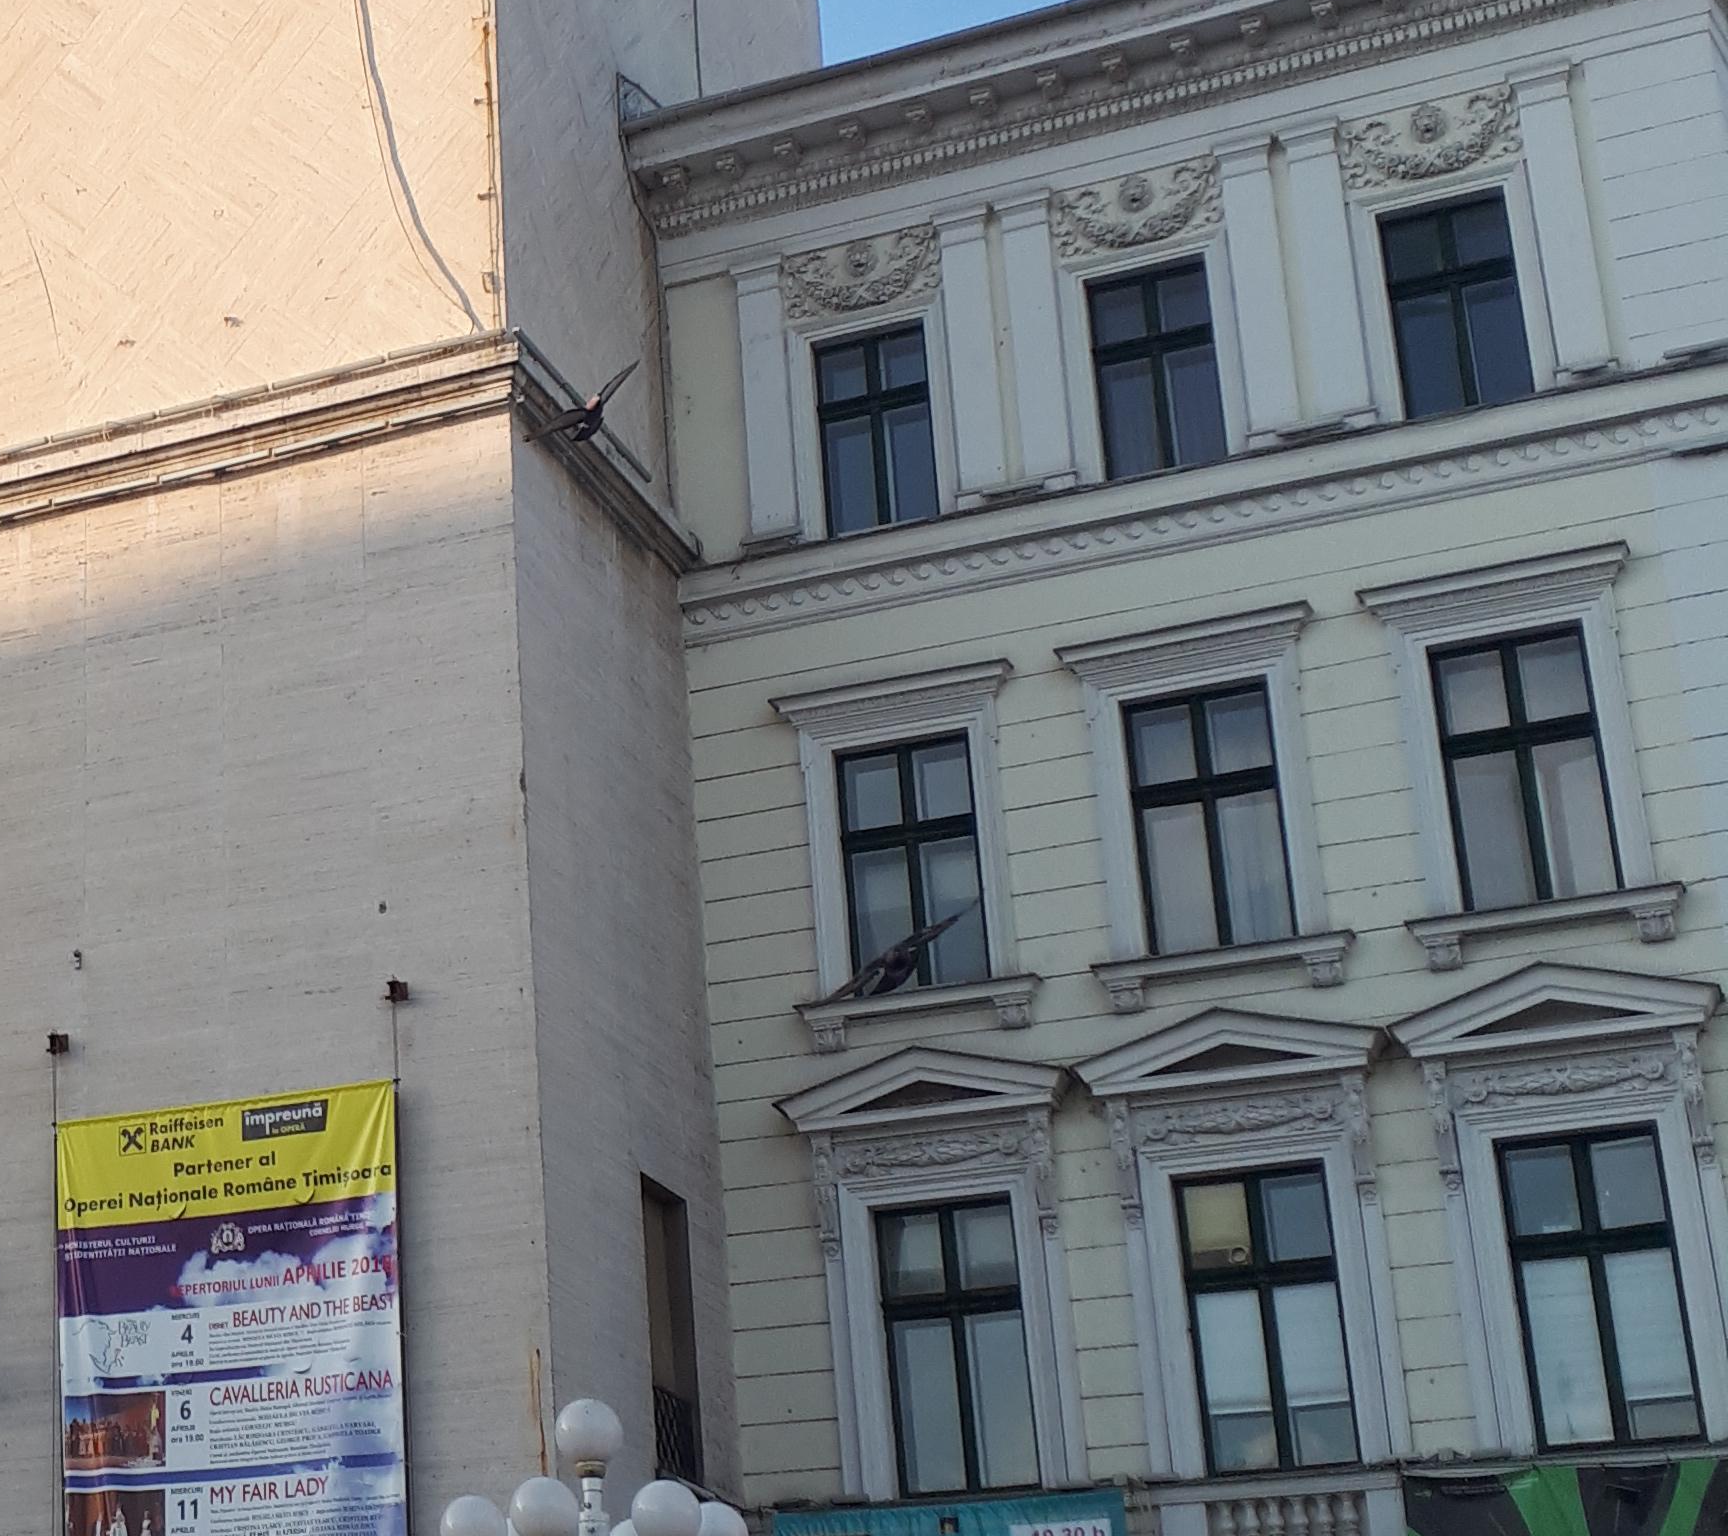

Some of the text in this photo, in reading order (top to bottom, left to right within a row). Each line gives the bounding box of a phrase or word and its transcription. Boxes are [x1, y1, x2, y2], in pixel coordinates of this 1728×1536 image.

[149, 1116, 224, 1136] Raiffeisen
[243, 1102, 323, 1135] împreună
[150, 1135, 196, 1153] BANK
[173, 1150, 277, 1178] Partener al
[63, 1162, 393, 1217] Operei Naționale Române Timișoara
[114, 1235, 156, 1247] CULTURII
[247, 1223, 272, 1235] OPERA
[249, 1275, 280, 1291] LUNII
[282, 1261, 347, 1286] APRILIE
[232, 1307, 288, 1329] BEAUTY
[289, 1302, 322, 1324] AND
[323, 1299, 350, 1318] THE
[352, 1293, 394, 1315] BEAST
[180, 1324, 193, 1345] 4
[209, 1369, 394, 1407] CAVALLERIA RUSTICANA
[180, 1400, 192, 1420] 6
[209, 1475, 329, 1506] MY FAIR LADY
[177, 1498, 199, 1521] 11
